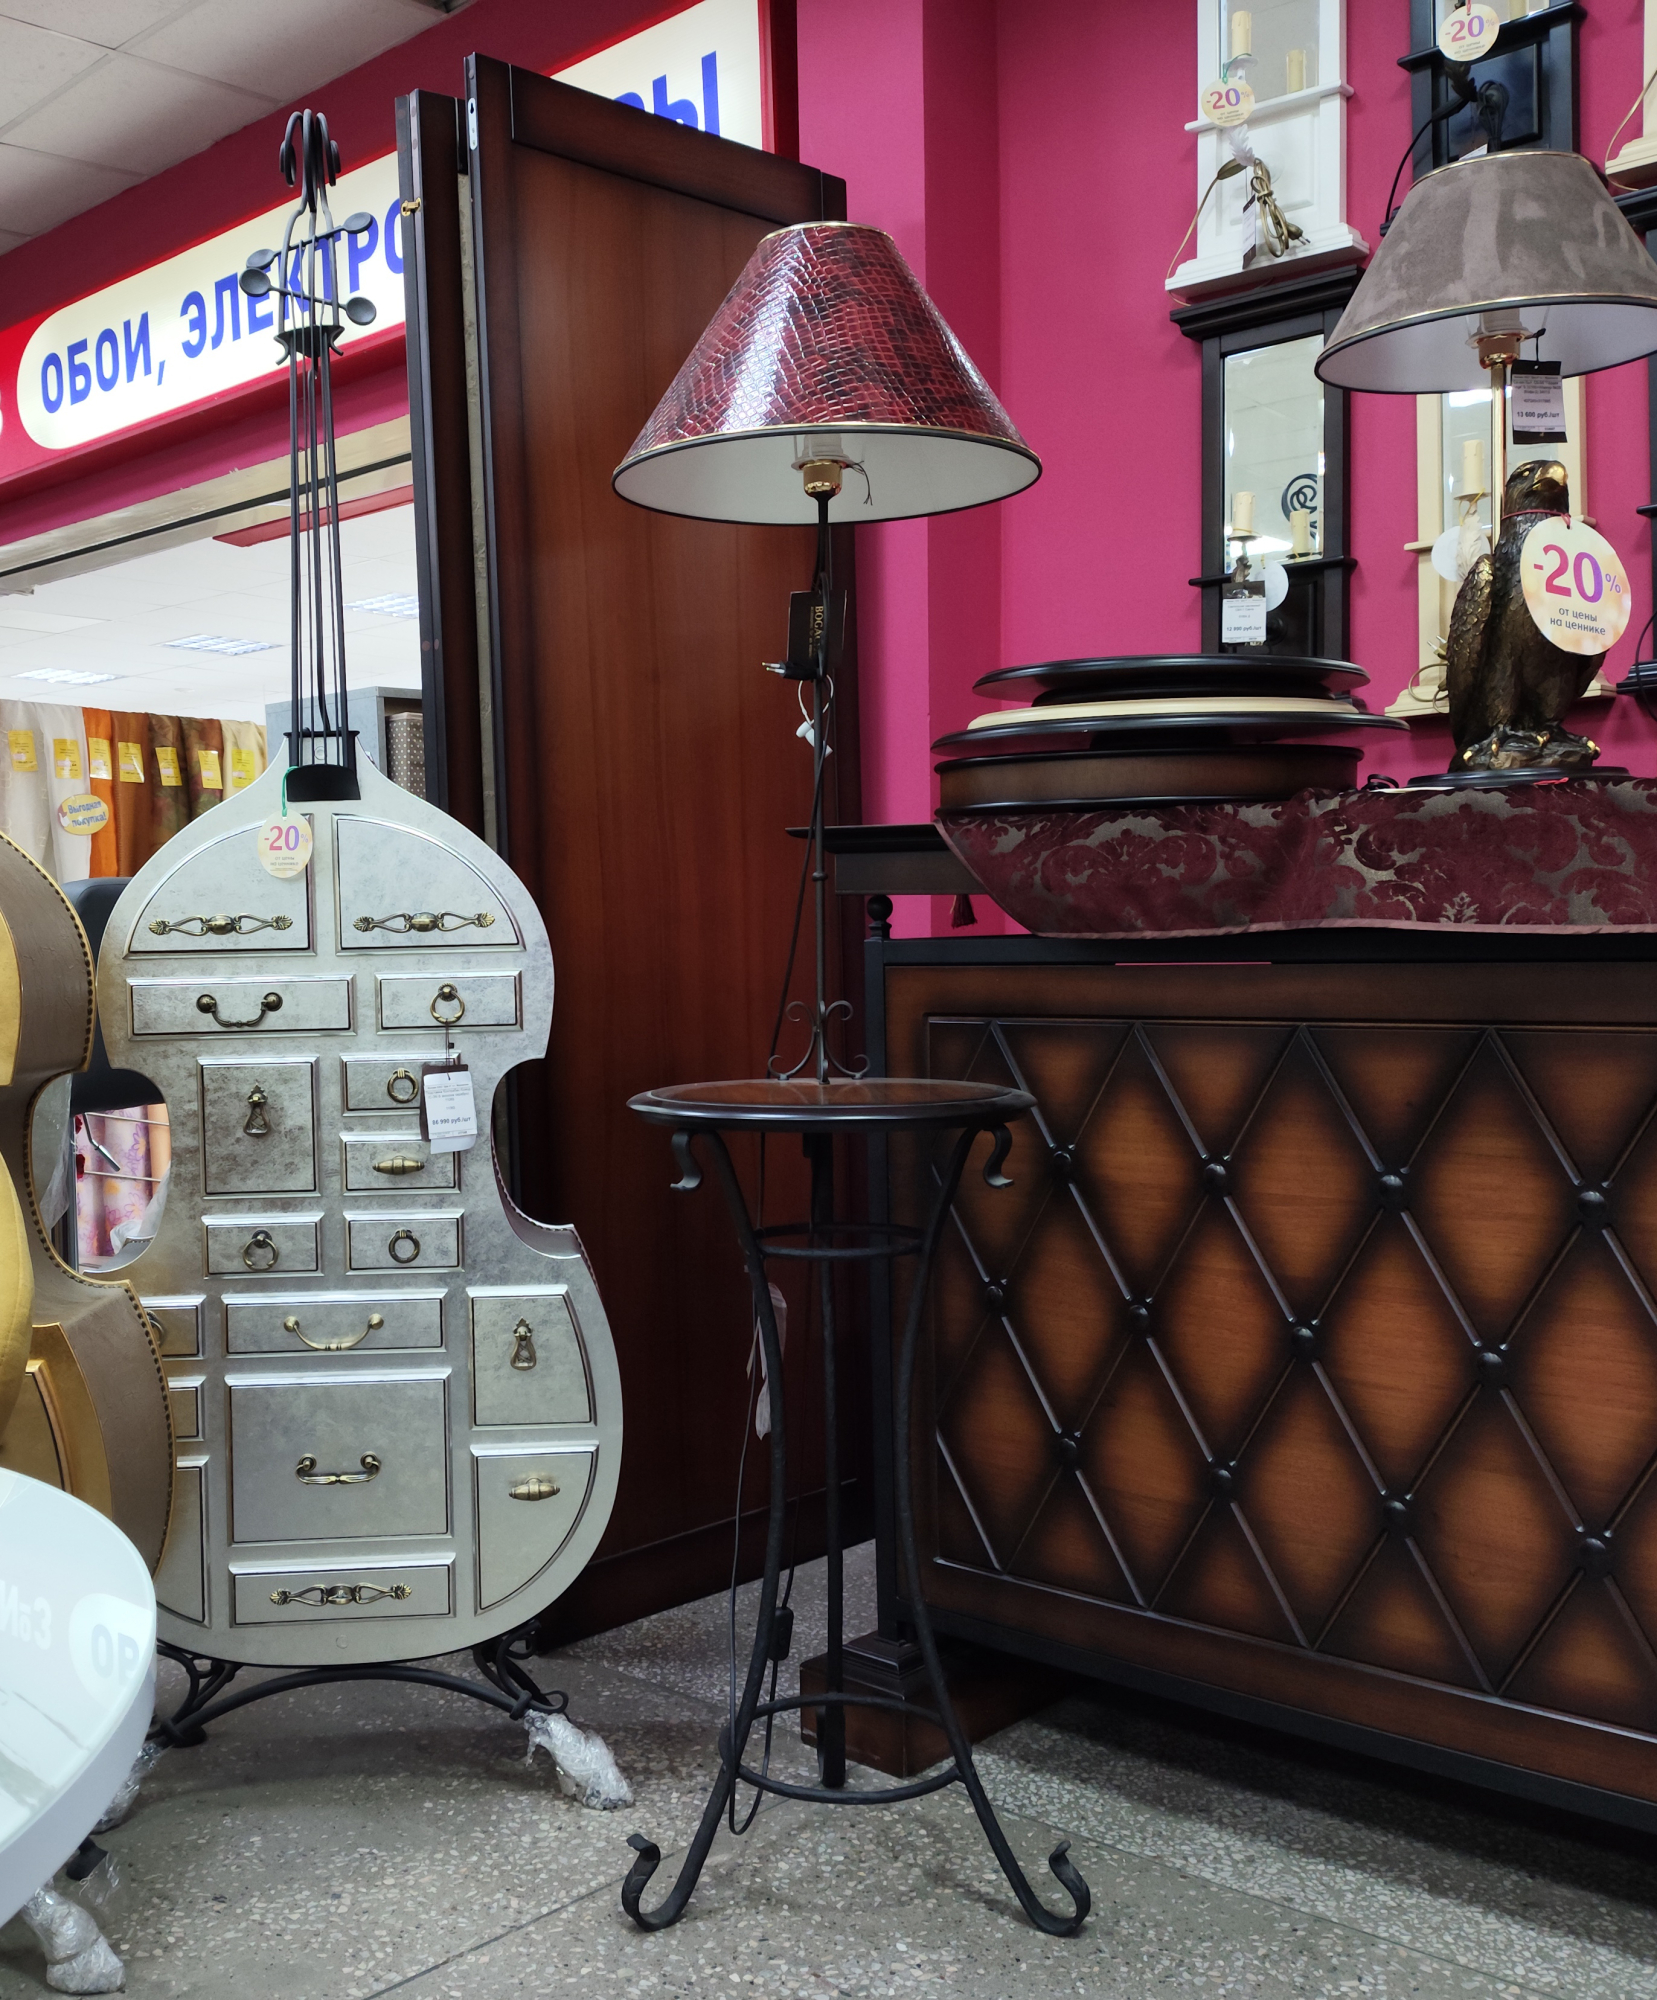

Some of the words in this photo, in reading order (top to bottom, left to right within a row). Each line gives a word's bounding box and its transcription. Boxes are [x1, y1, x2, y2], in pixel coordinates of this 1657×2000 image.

[1445, 15, 1495, 43] -20%
[1206, 87, 1250, 110] -20%
[41, 311, 166, 414] ОБОИ,
[1533, 544, 1622, 604] -20%
[1558, 607, 1570, 617] от
[1572, 610, 1598, 622] цены
[1550, 617, 1563, 627] на
[1565, 621, 1606, 636] ценнике
[67, 800, 102, 814] Выгодная
[71, 811, 107, 827] покупка!
[264, 825, 309, 851] -20%
